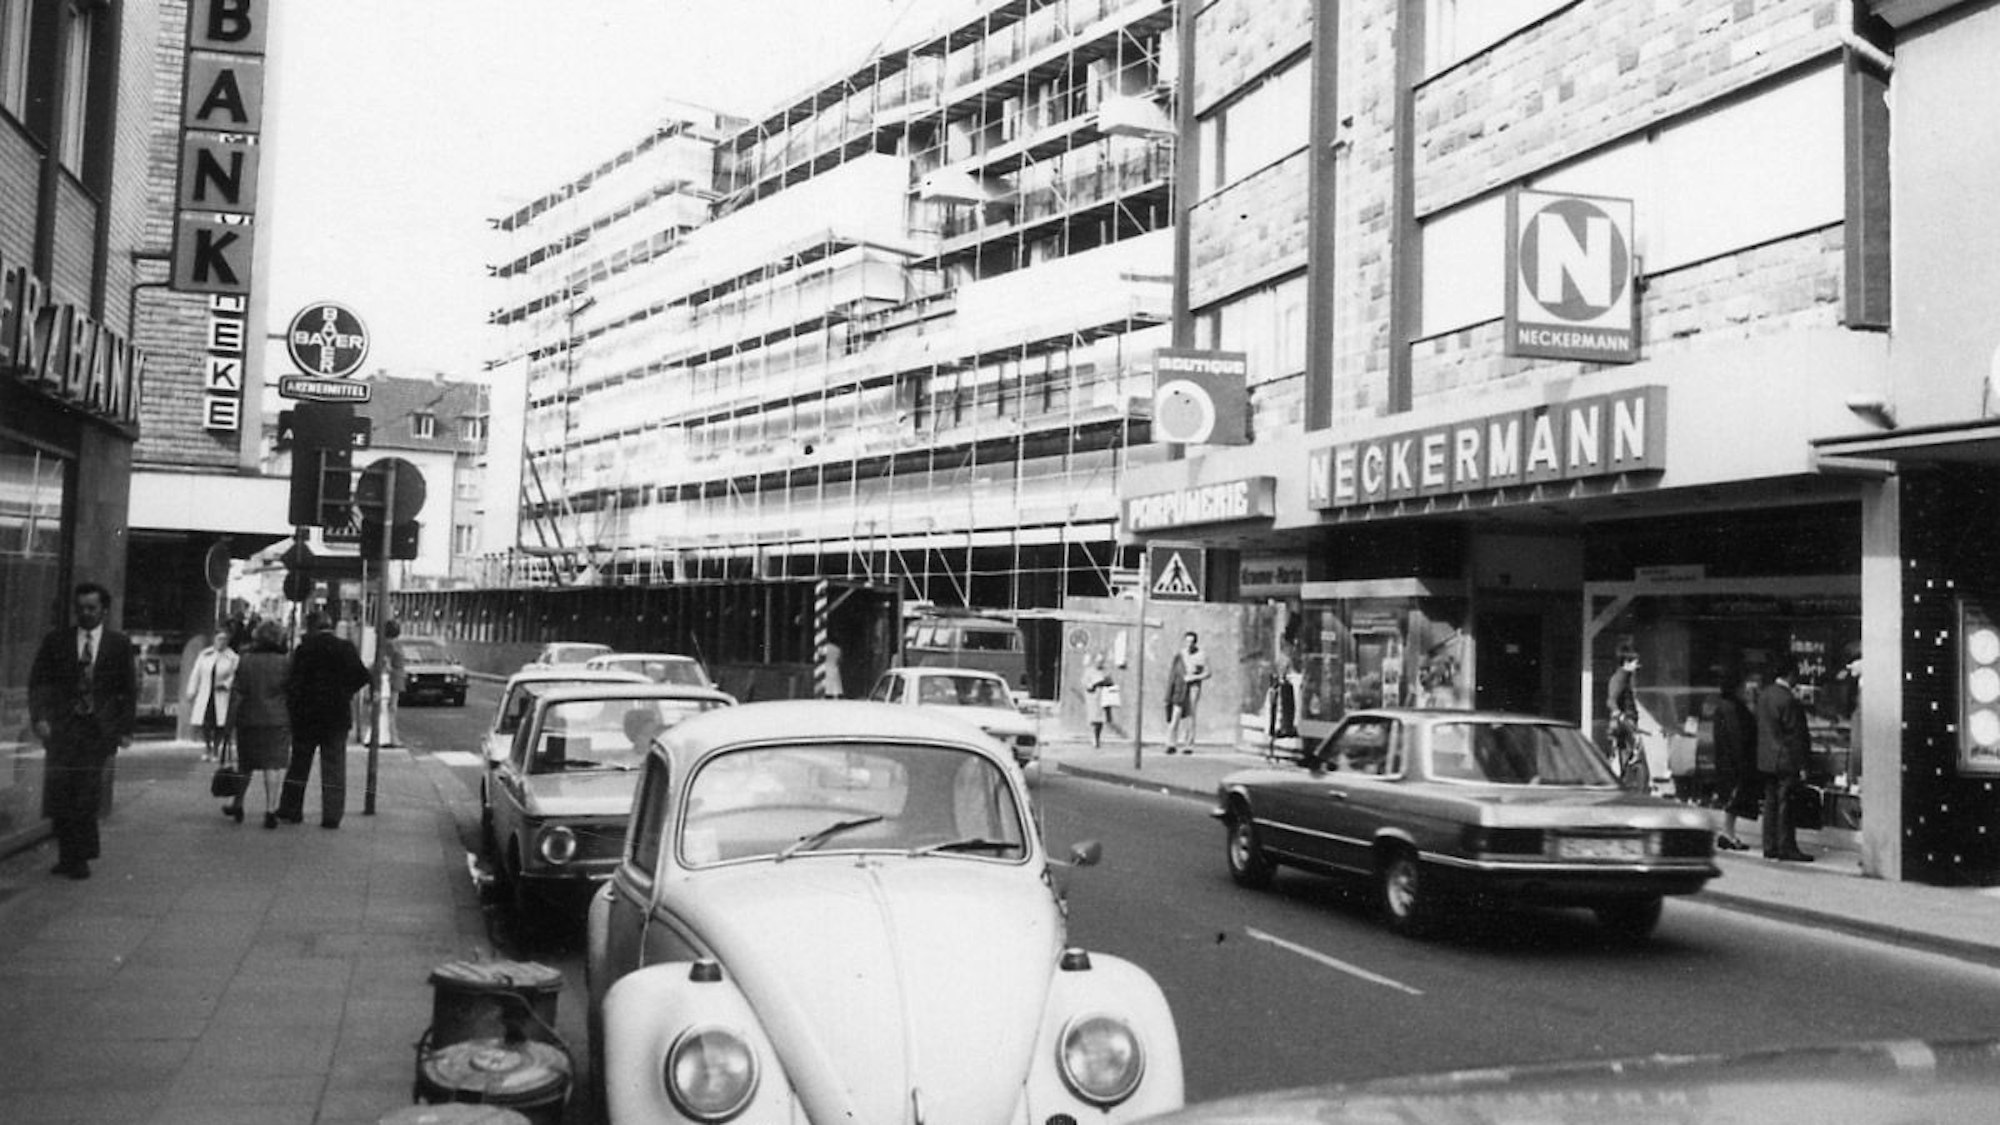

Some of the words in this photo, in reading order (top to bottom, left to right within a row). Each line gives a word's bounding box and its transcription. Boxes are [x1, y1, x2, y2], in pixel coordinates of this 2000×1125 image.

[193, 0, 252, 285] BANK
[1538, 212, 1612, 307] N
[295, 331, 363, 349] BAYER
[320, 307, 338, 373] BAYER
[1519, 329, 1629, 351] NECKERMANN
[1159, 358, 1245, 375] BOUTIQUE
[286, 381, 365, 397] ARZNEIMITTEL
[1309, 397, 1645, 502] NECKERMANN
